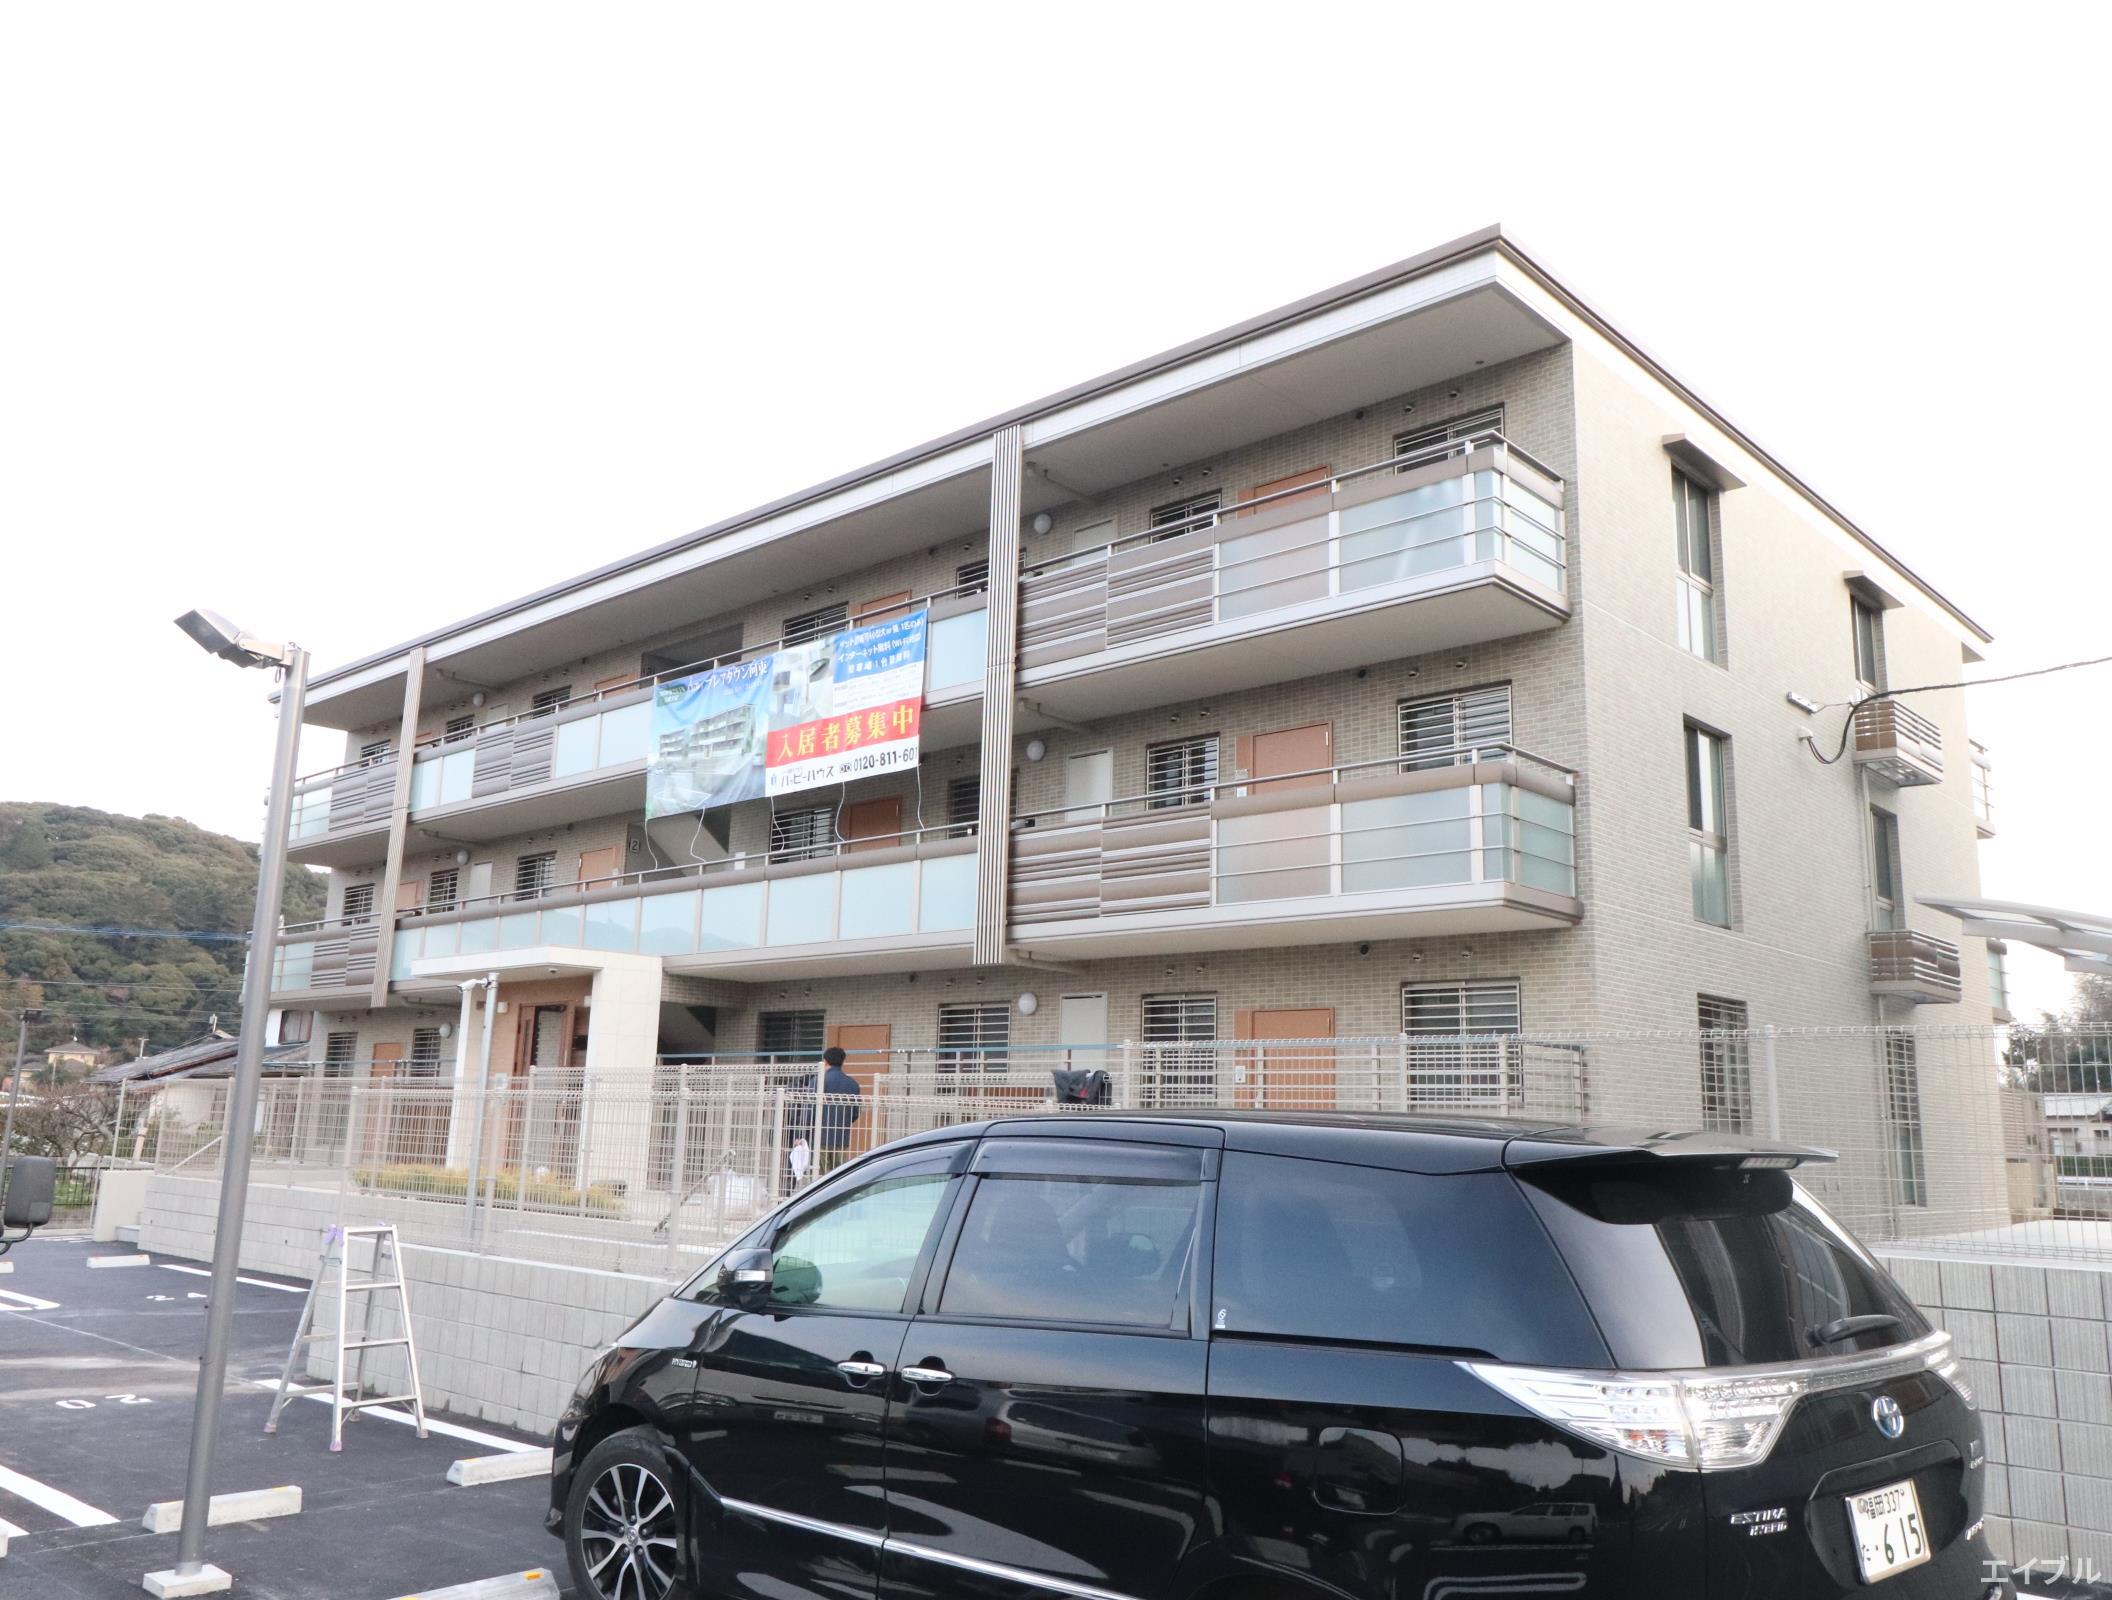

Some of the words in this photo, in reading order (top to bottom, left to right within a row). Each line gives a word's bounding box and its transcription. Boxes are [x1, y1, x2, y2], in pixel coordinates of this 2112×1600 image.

[777, 704, 914, 761] 入居者募集中
[1730, 1507, 1787, 1524] ESTIMA
